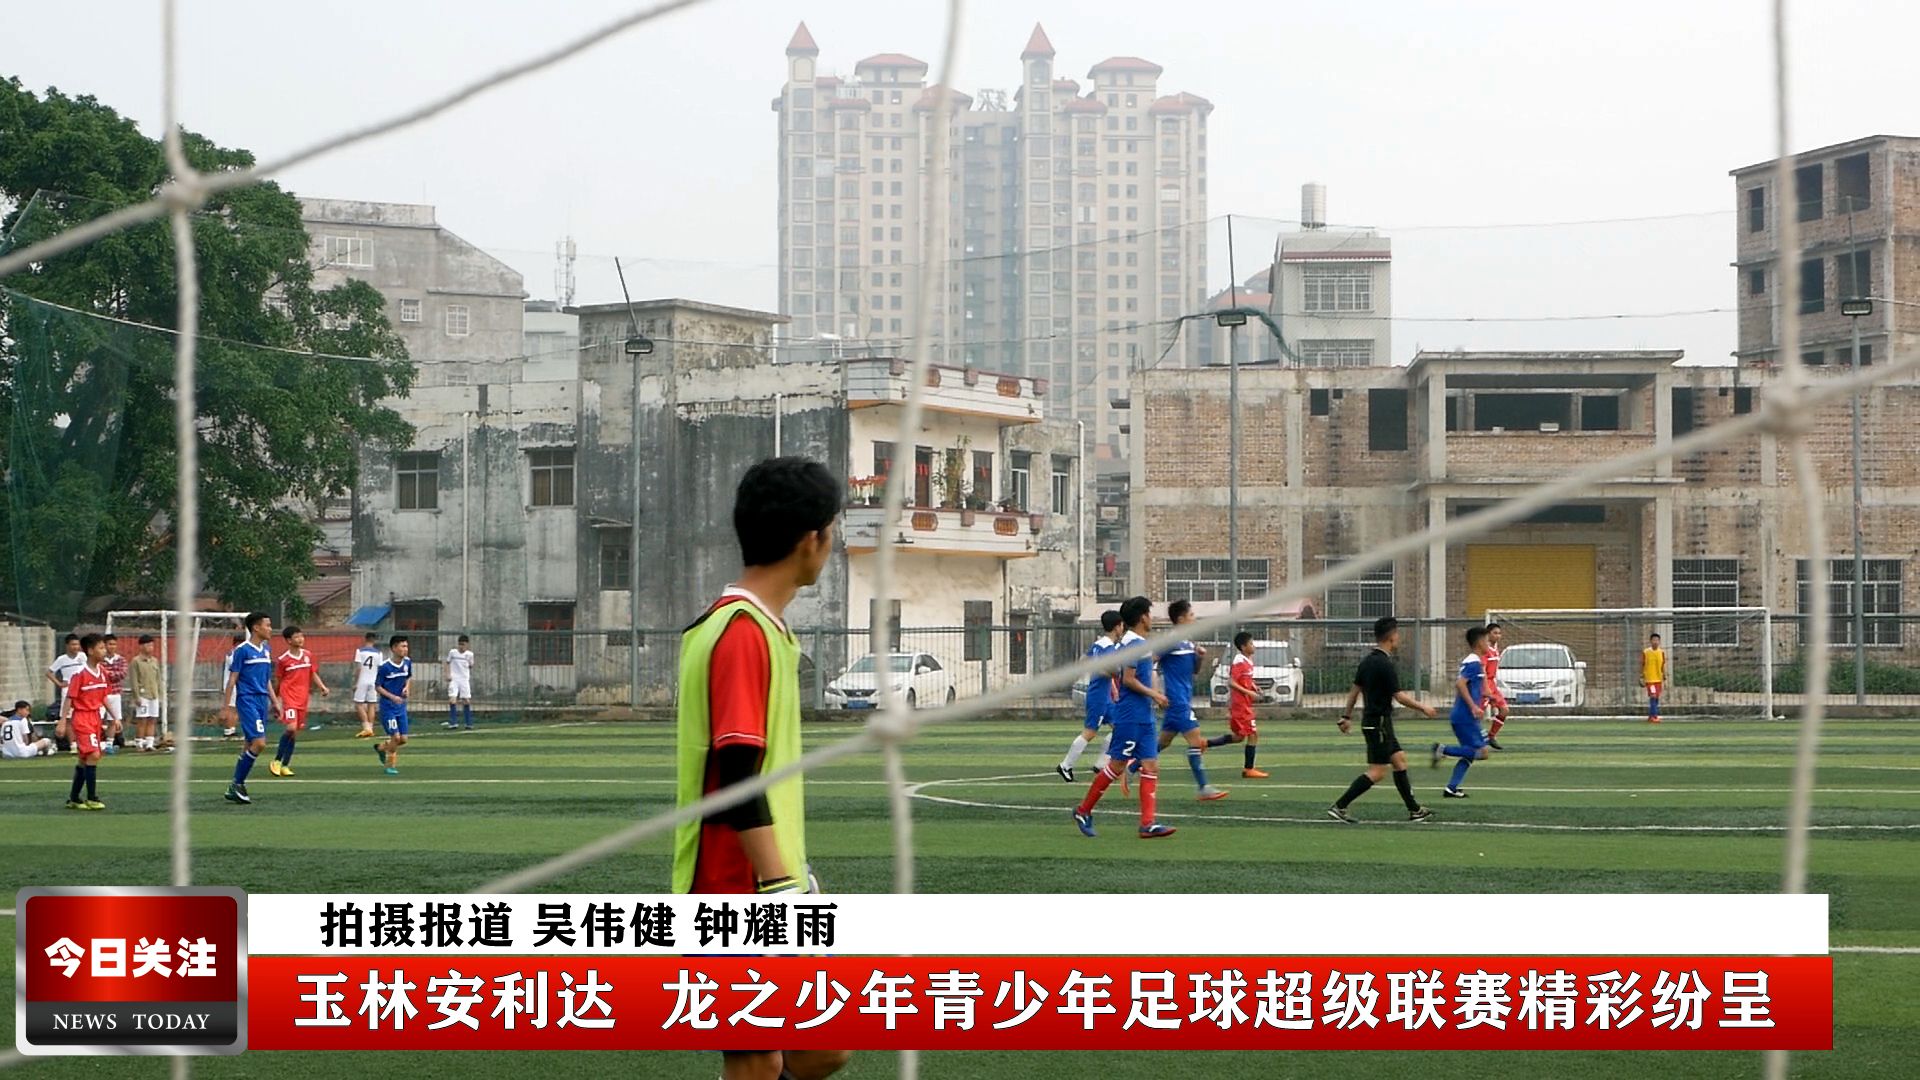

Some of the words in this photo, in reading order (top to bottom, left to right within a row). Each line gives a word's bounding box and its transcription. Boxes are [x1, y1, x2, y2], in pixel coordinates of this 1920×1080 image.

[363, 655, 373, 670] 4
[285, 708, 296, 720] 10
[388, 719, 398, 730] 10
[3, 725, 13, 741] 8
[90, 733, 99, 747] 6
[1122, 740, 1136, 756] 2
